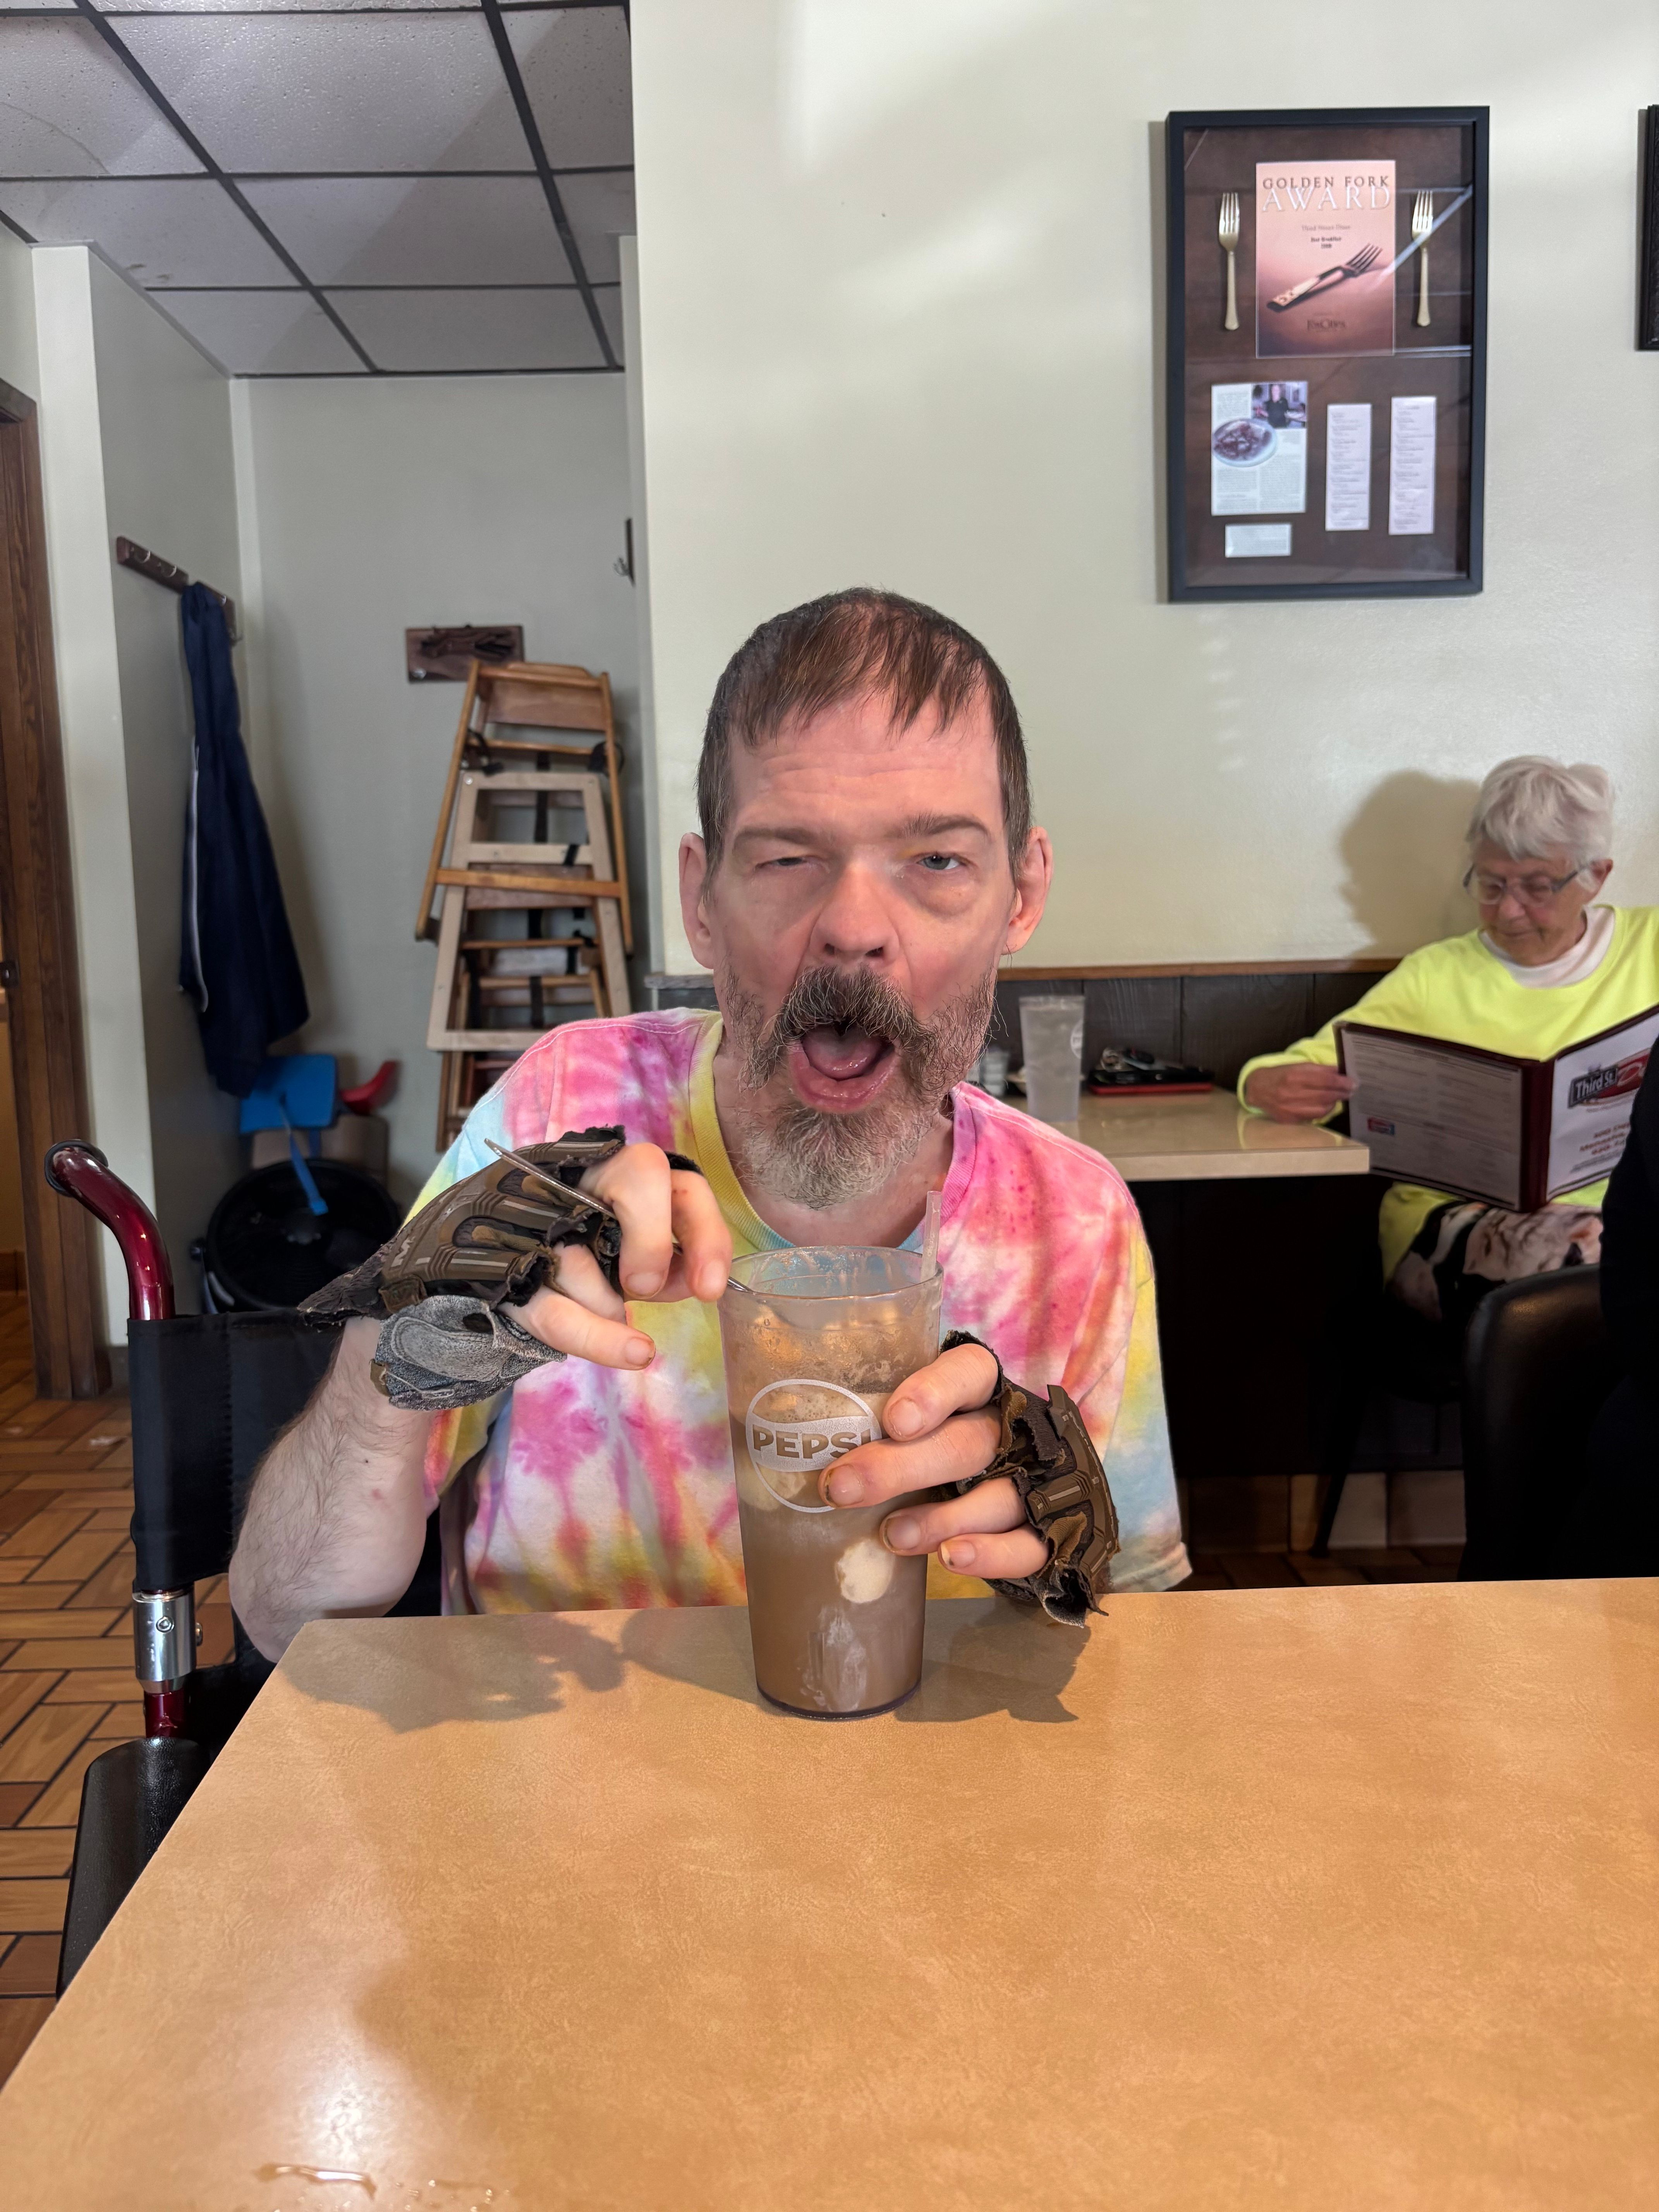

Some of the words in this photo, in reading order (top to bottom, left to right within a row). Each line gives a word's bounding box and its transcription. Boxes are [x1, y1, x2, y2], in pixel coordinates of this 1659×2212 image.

[1262, 176, 1334, 189] GOLDEN
[1345, 175, 1389, 188] FORK
[1262, 185, 1391, 212] AWARD
[1576, 1074, 1604, 1099] Third
